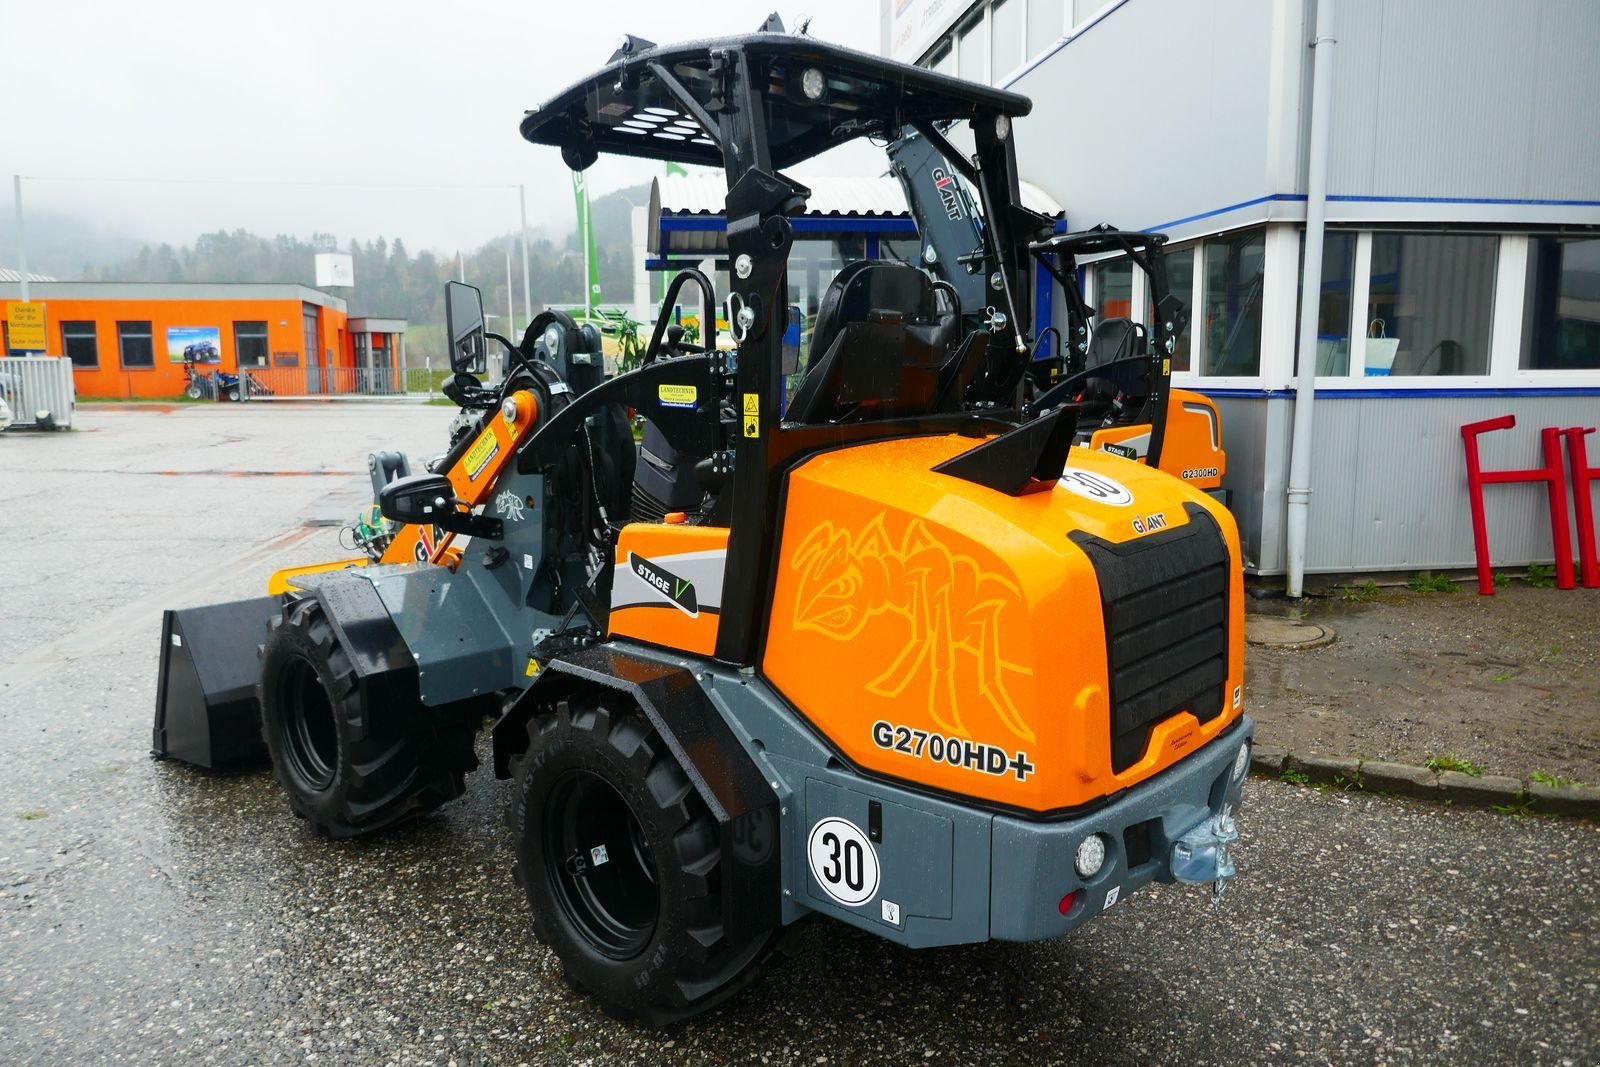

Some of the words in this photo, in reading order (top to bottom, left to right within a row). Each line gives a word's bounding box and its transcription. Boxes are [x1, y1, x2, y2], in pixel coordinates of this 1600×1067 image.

[659, 386, 696, 394] LANDTECHNIK
[1107, 446, 1125, 456] STAGE
[1061, 472, 1121, 497] 30
[1182, 468, 1218, 479] G2300HD
[637, 563, 670, 594] STAGE
[674, 578, 692, 600] V
[872, 720, 1035, 781] G2700HD+
[822, 832, 864, 892] 30
